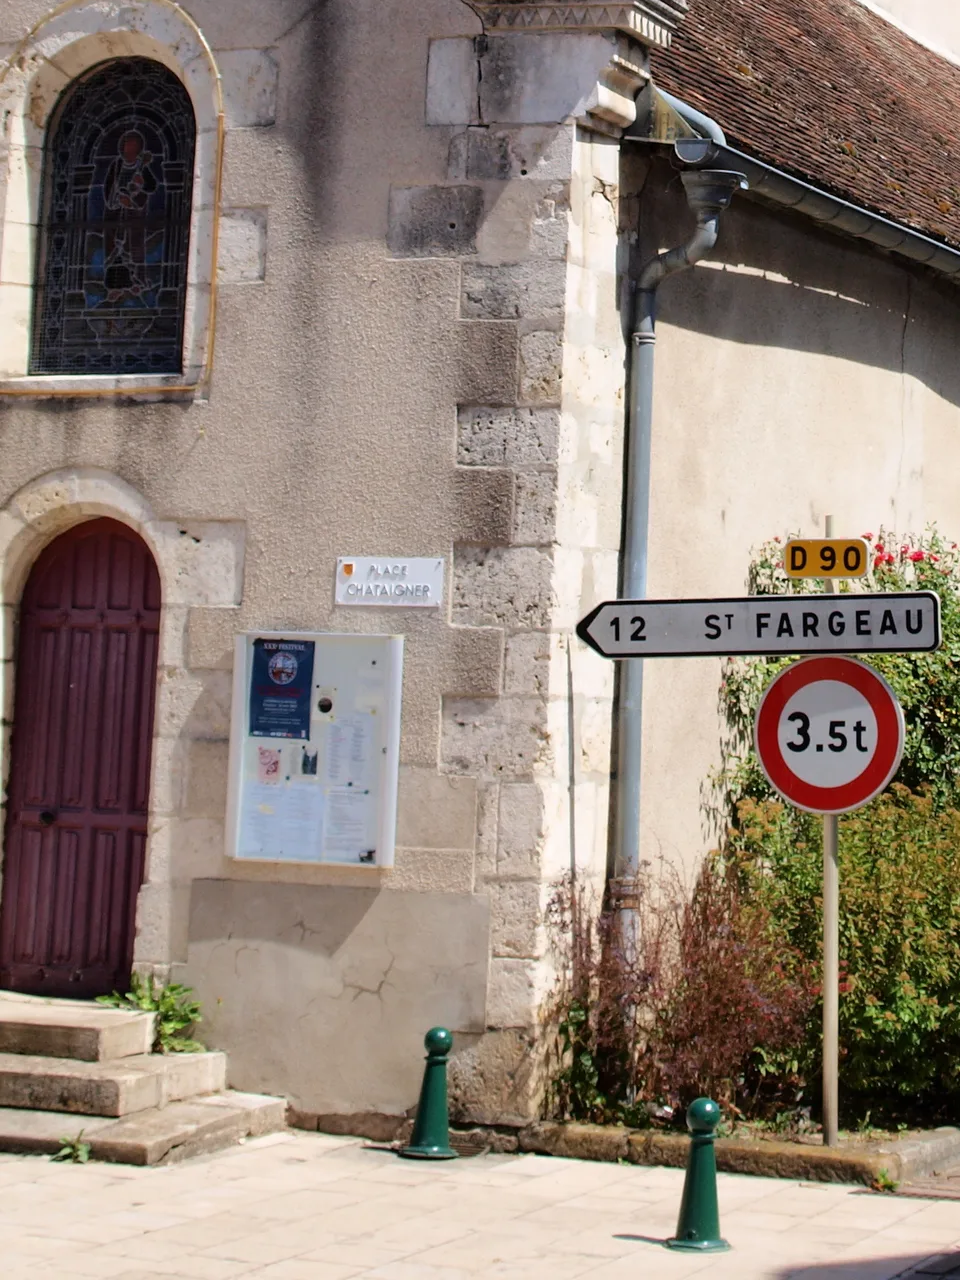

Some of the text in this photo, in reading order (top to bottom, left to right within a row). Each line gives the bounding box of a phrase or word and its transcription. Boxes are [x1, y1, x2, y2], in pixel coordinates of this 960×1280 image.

[369, 565, 408, 576] PLACE
[790, 546, 861, 571] D 90
[346, 583, 430, 596] CHATAIGNER
[610, 616, 646, 642] 12
[756, 609, 923, 638] FARGEAU
[786, 711, 868, 753] 3.5t
